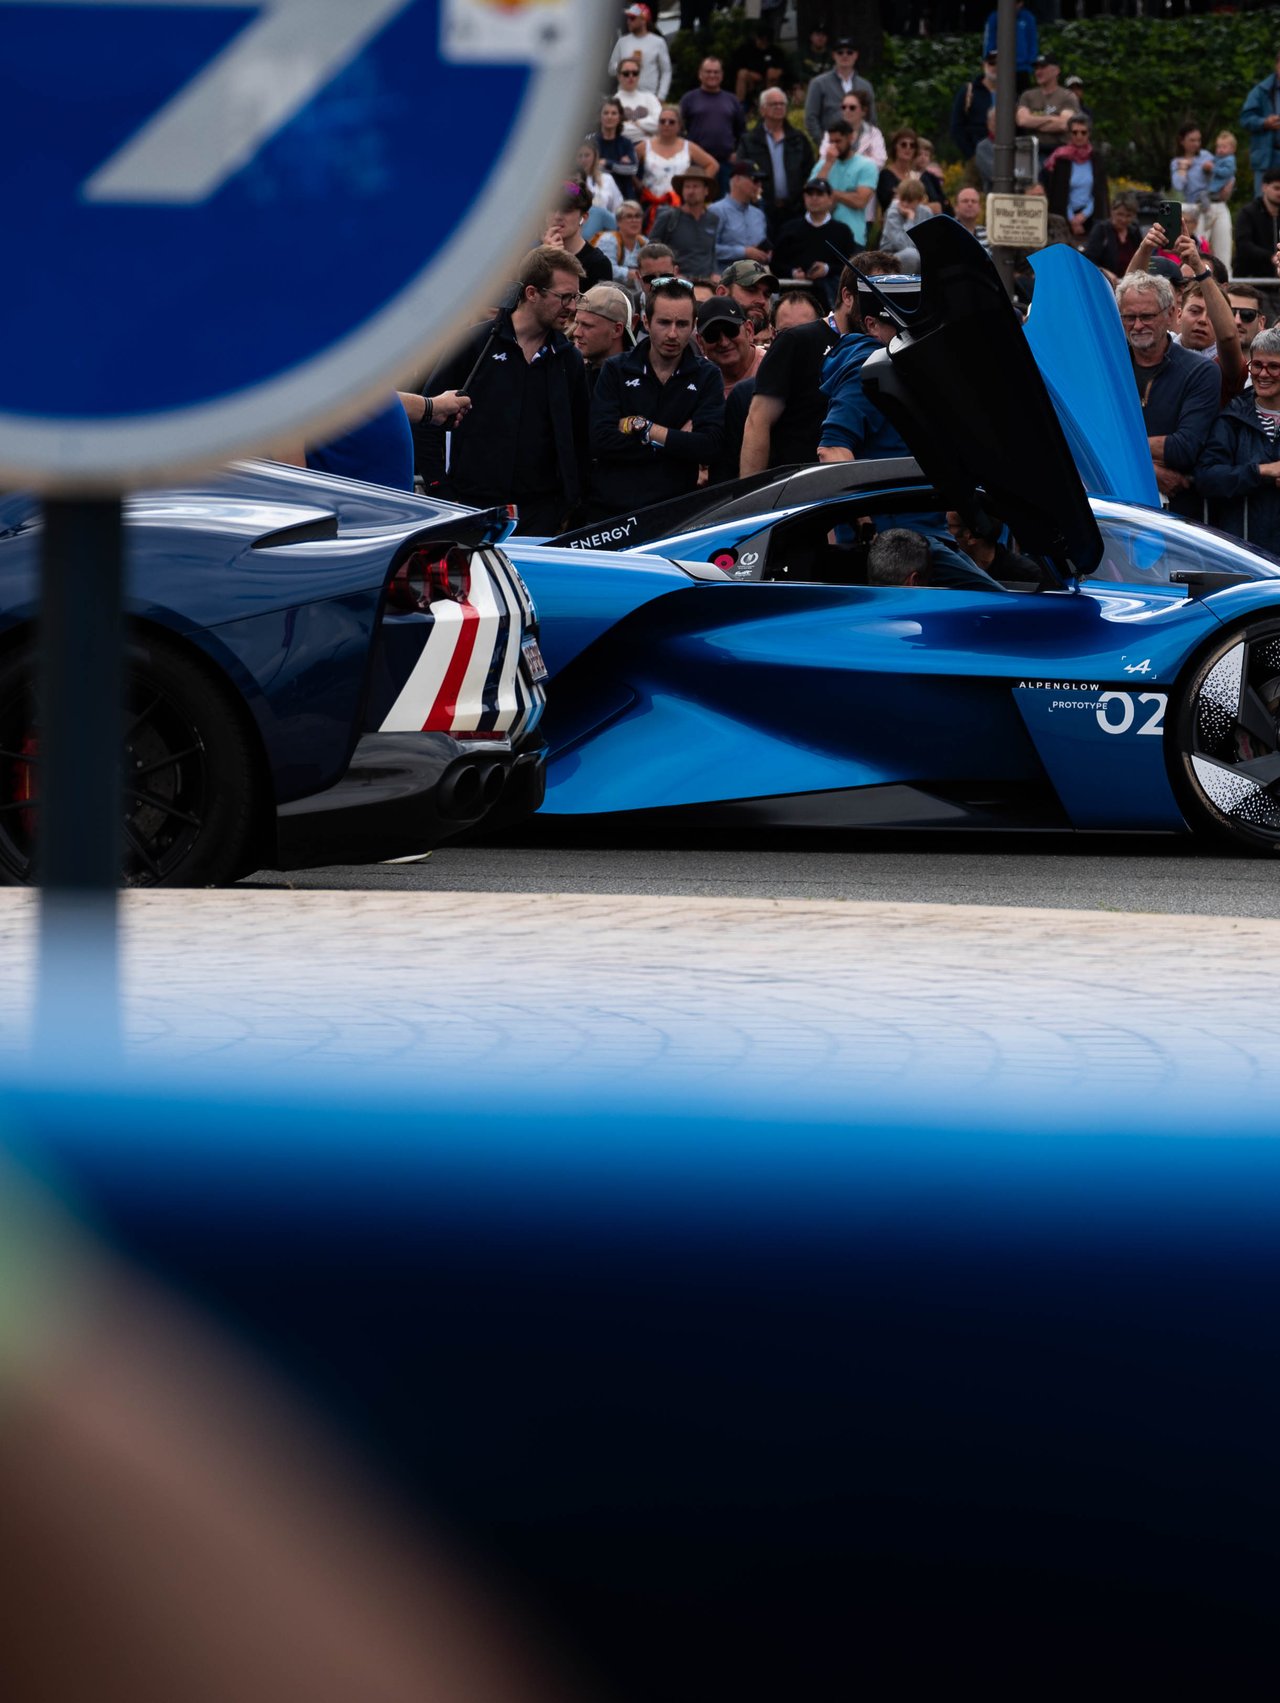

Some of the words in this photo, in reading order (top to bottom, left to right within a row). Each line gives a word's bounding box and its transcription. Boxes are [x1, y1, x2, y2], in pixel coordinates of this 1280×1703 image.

[569, 524, 631, 550] ENERGY
[1018, 681, 1101, 691] ALPENGLOW
[1052, 700, 1108, 710] PROTOTYPE
[1095, 691, 1169, 736] 02
